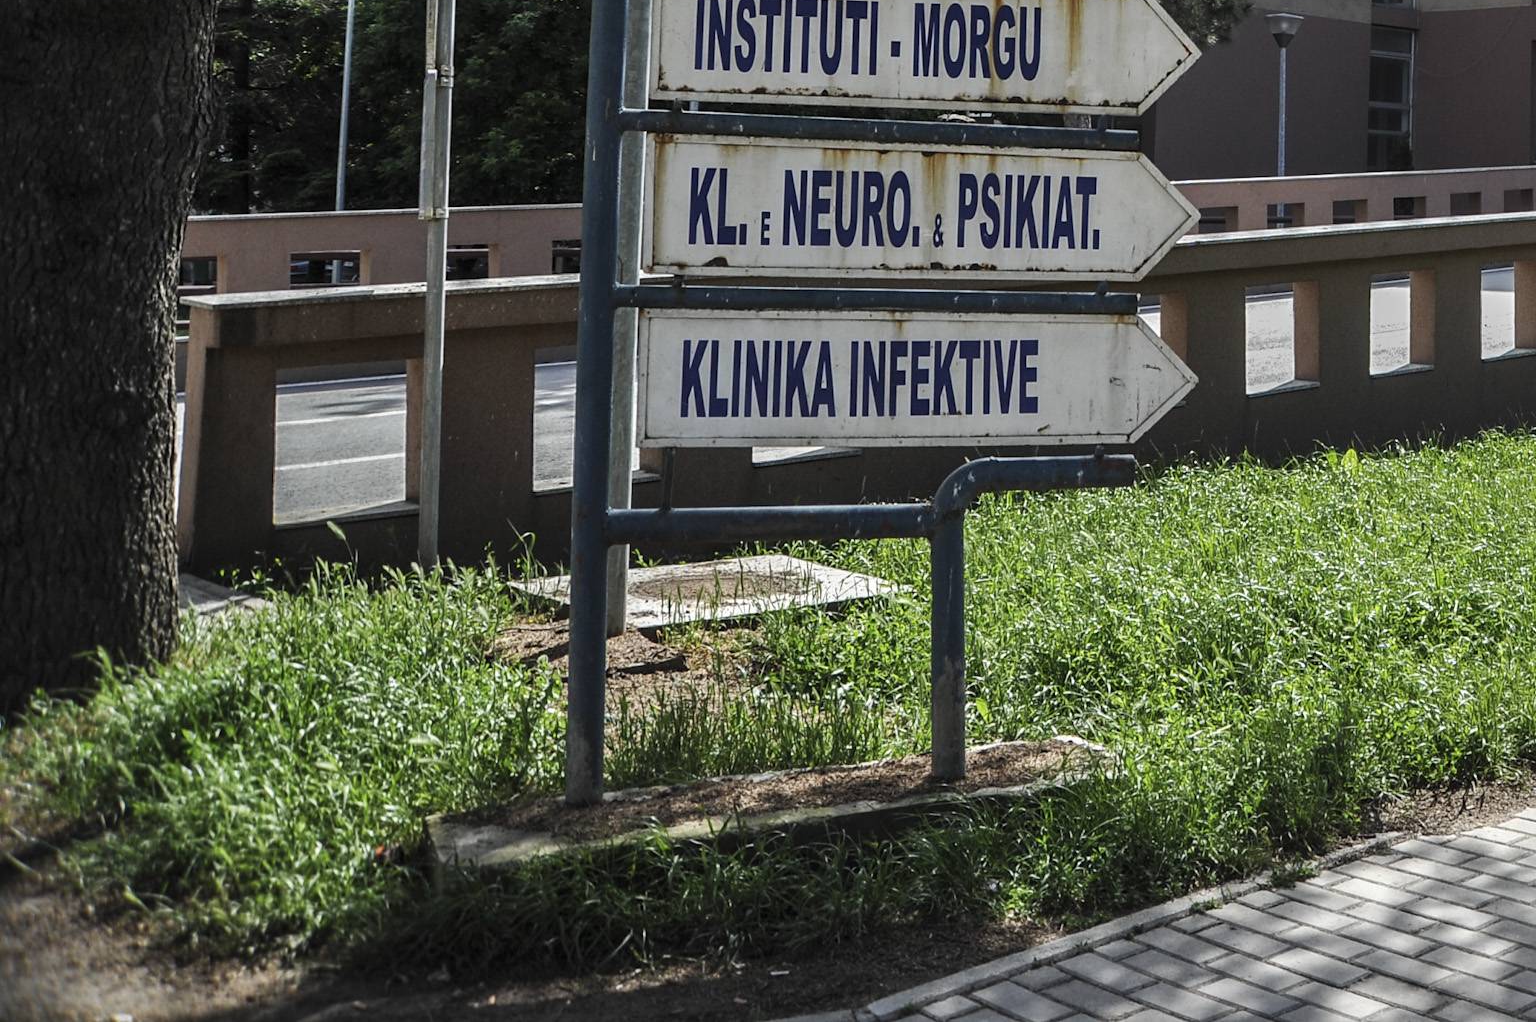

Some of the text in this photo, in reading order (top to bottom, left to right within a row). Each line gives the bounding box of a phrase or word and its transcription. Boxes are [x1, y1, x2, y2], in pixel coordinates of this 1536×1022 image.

[912, 2, 1042, 81] MORGU
[688, 167, 1100, 251] KL. E NEURO. & PSIKIAT.
[680, 338, 1040, 419] KLINIKA INFEKTIVE
